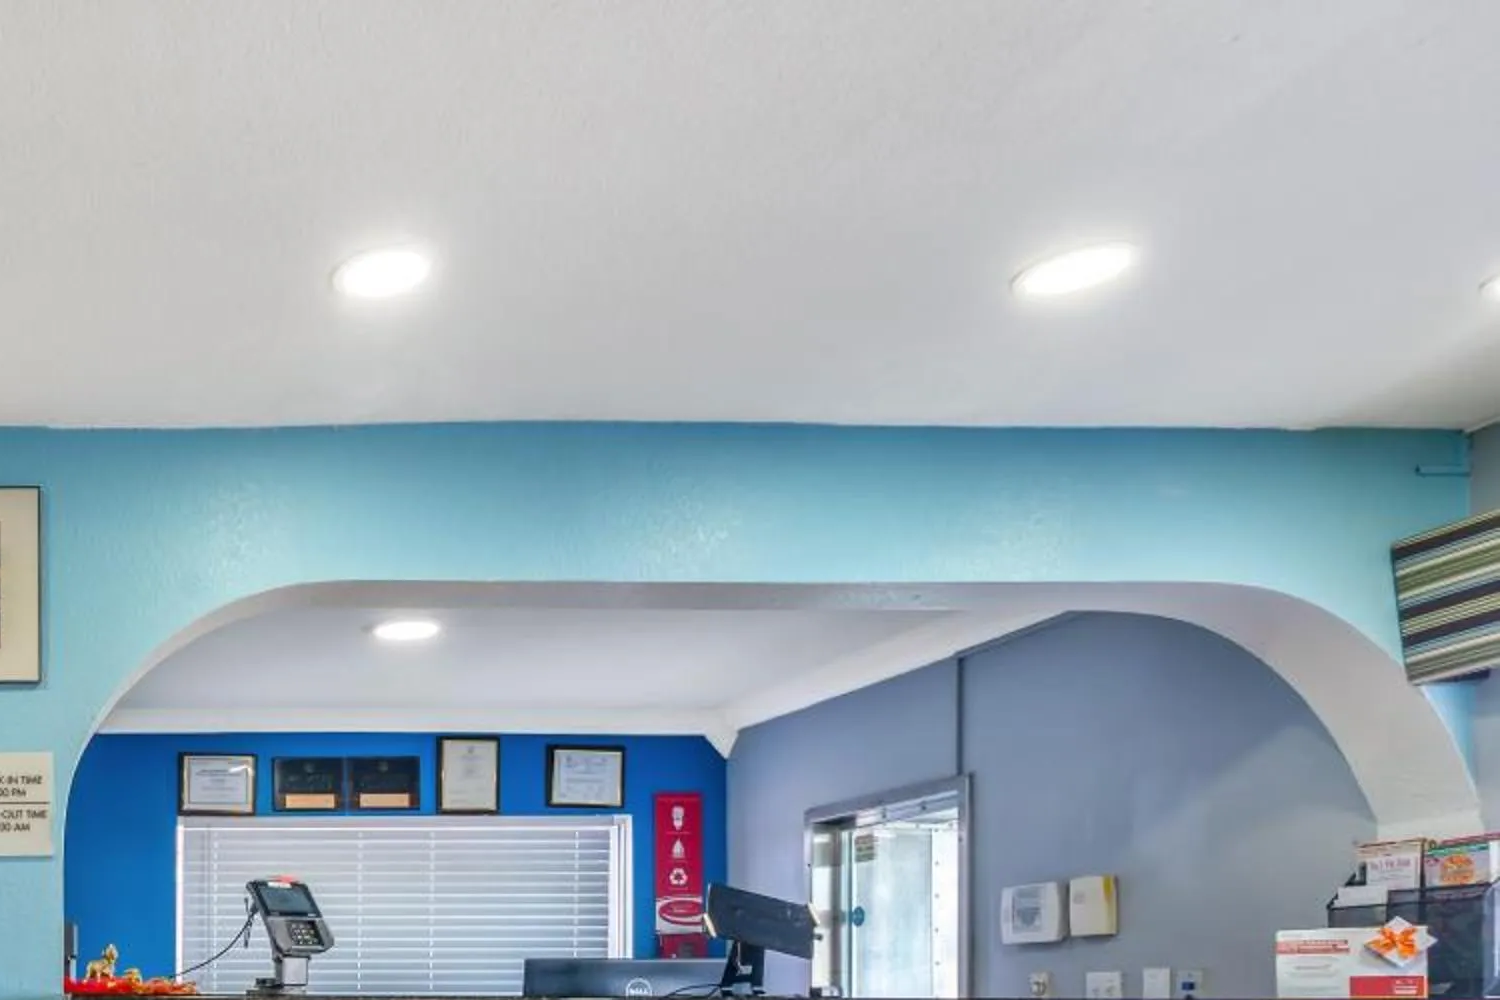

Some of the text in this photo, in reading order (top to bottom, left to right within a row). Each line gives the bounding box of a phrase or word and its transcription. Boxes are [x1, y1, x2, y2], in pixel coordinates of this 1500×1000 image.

[21, 775, 42, 785] TIME
[11, 787, 27, 796] PM
[26, 809, 48, 819] TIME
[14, 822, 31, 832] AM
